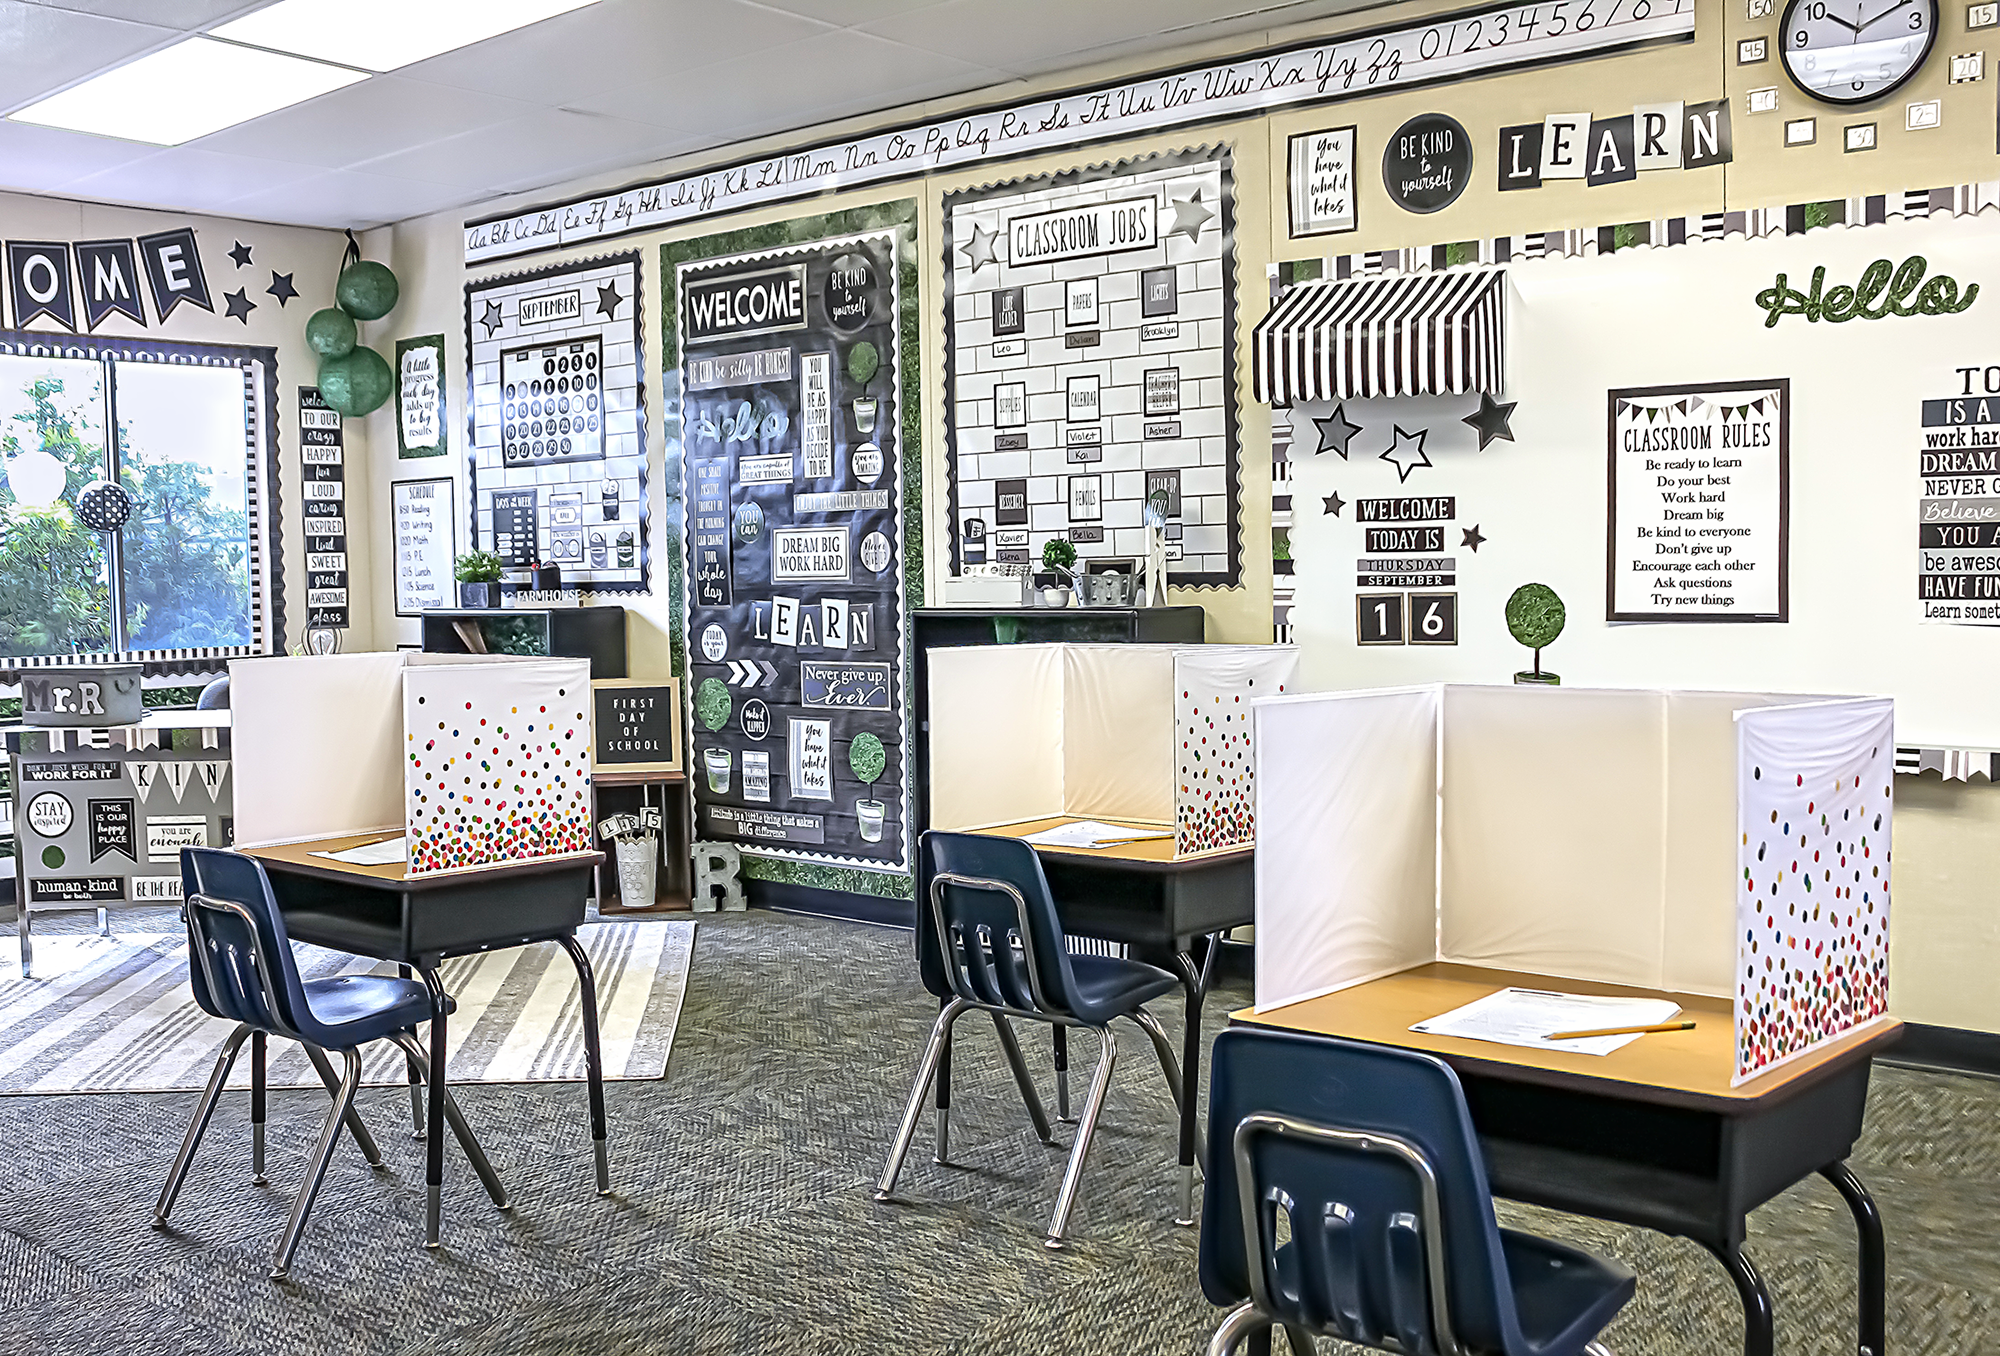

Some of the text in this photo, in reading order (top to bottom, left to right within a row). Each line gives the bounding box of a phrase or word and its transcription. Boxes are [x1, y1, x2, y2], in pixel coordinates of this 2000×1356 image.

[1804, 2, 1826, 21] 10
[1974, 9, 1992, 25] 15
[1909, 12, 1922, 30] 3
[1795, 30, 1809, 49] 9
[1743, 42, 1762, 57] 45
[793, 155, 837, 180] Mm
[845, 145, 878, 170] Nn
[887, 135, 916, 161] Oo
[924, 127, 950, 163] Pp
[999, 112, 1029, 141] Rr
[1118, 87, 1155, 117] Uu
[1260, 58, 1305, 89] Xx
[1313, 48, 1357, 93] Yy
[1367, 38, 1403, 84] Zz
[1316, 136, 1343, 164] You
[1400, 129, 1454, 160] BE KIND
[1509, 110, 1720, 179] LEARN
[1314, 156, 1344, 174] have
[1419, 157, 1431, 173] to
[1310, 176, 1337, 196] what
[1401, 174, 1454, 198] yourself
[1313, 197, 1345, 216] takes
[1017, 206, 1147, 258] CLASSROOM JOBS
[832, 267, 867, 290] BE KIND
[1755, 255, 1980, 329] Hello
[522, 295, 577, 320] SEPTEMBER
[691, 280, 802, 331] WELCOME
[832, 296, 867, 321] yourself
[1072, 292, 1092, 311] PAPERS
[1144, 325, 1176, 338] Brooklyn
[1069, 335, 1094, 346] Dylan
[997, 344, 1011, 354] Leo
[729, 349, 790, 381] silly HONEST
[810, 358, 822, 373] YOU
[808, 375, 824, 391] WILL
[807, 393, 826, 408] BE AS
[806, 408, 827, 425] HAPPY
[1945, 398, 1992, 424] IS A
[303, 412, 338, 427] TO OUR
[307, 430, 335, 445] crazy
[815, 426, 829, 441] YOU
[1070, 431, 1098, 442] Violet
[1149, 426, 1173, 436] Asher
[1624, 422, 1771, 453] CLASSROOM RULES
[1925, 427, 1966, 448] work
[306, 448, 338, 462] HAPPY
[806, 443, 829, 459] DECIDE
[1645, 457, 1742, 473] Be ready to learn
[1922, 451, 1997, 475] DREAM
[315, 465, 330, 481] fun
[741, 468, 792, 480] GREAT THINGS
[1656, 474, 1731, 489] Do your best
[1925, 478, 1987, 497] NEVER
[312, 484, 335, 498] LOUD
[408, 484, 435, 500] SCHEDULE
[1661, 491, 1726, 504] Work hard
[308, 501, 338, 517] caring
[739, 510, 759, 524] YOU
[1361, 498, 1449, 521] WELCOME
[1663, 508, 1724, 522] Dream big
[1924, 500, 1997, 522] Believe
[306, 519, 343, 534] INSPIRED
[412, 521, 433, 533] Writing
[740, 523, 758, 536] can
[1637, 526, 1752, 539] Be kind to everyone
[999, 533, 1025, 542] Xavier
[1072, 530, 1097, 540] Bella
[1370, 529, 1439, 550] TODAY IS
[1936, 527, 1980, 546] YOU
[782, 536, 840, 554] DREAM BIG
[1655, 543, 1733, 557] Don't give up
[311, 555, 342, 569] SWEET
[779, 555, 844, 572] WORK HARD
[1366, 559, 1445, 572] THURSDAY
[1632, 559, 1756, 574] Encourage each other
[1923, 552, 1946, 572] be
[314, 571, 340, 589] great
[697, 564, 726, 582] whole
[1368, 575, 1443, 586] SEPTEMBER
[703, 581, 723, 602] day
[1653, 576, 1733, 591] Ask questions
[1924, 576, 1966, 598] HAVE
[309, 591, 345, 605] AWESOME
[516, 589, 581, 602] FARMHOUSE
[1650, 594, 1735, 608] Try new things
[1924, 602, 1962, 619] Learn
[754, 603, 869, 646] LEARN
[805, 667, 886, 686] Never give up.
[806, 680, 886, 706] Ever.
[613, 698, 655, 709] FIRST
[619, 712, 646, 723] DAY
[623, 726, 639, 737] OF
[805, 724, 823, 740] You
[608, 740, 659, 751] SCHOOL
[804, 740, 825, 753] have
[802, 756, 820, 769] what
[31, 769, 113, 781] WORK FOR IT
[804, 772, 825, 787] takes
[35, 801, 65, 817] STAY
[100, 804, 122, 813] THIS
[95, 814, 128, 822] IS OUR
[97, 823, 127, 835] happy
[738, 822, 787, 839] BIG difference
[98, 835, 128, 844] PLACE
[690, 840, 747, 913] R
[36, 878, 118, 893] human-kind
[137, 881, 164, 897] BE THE
